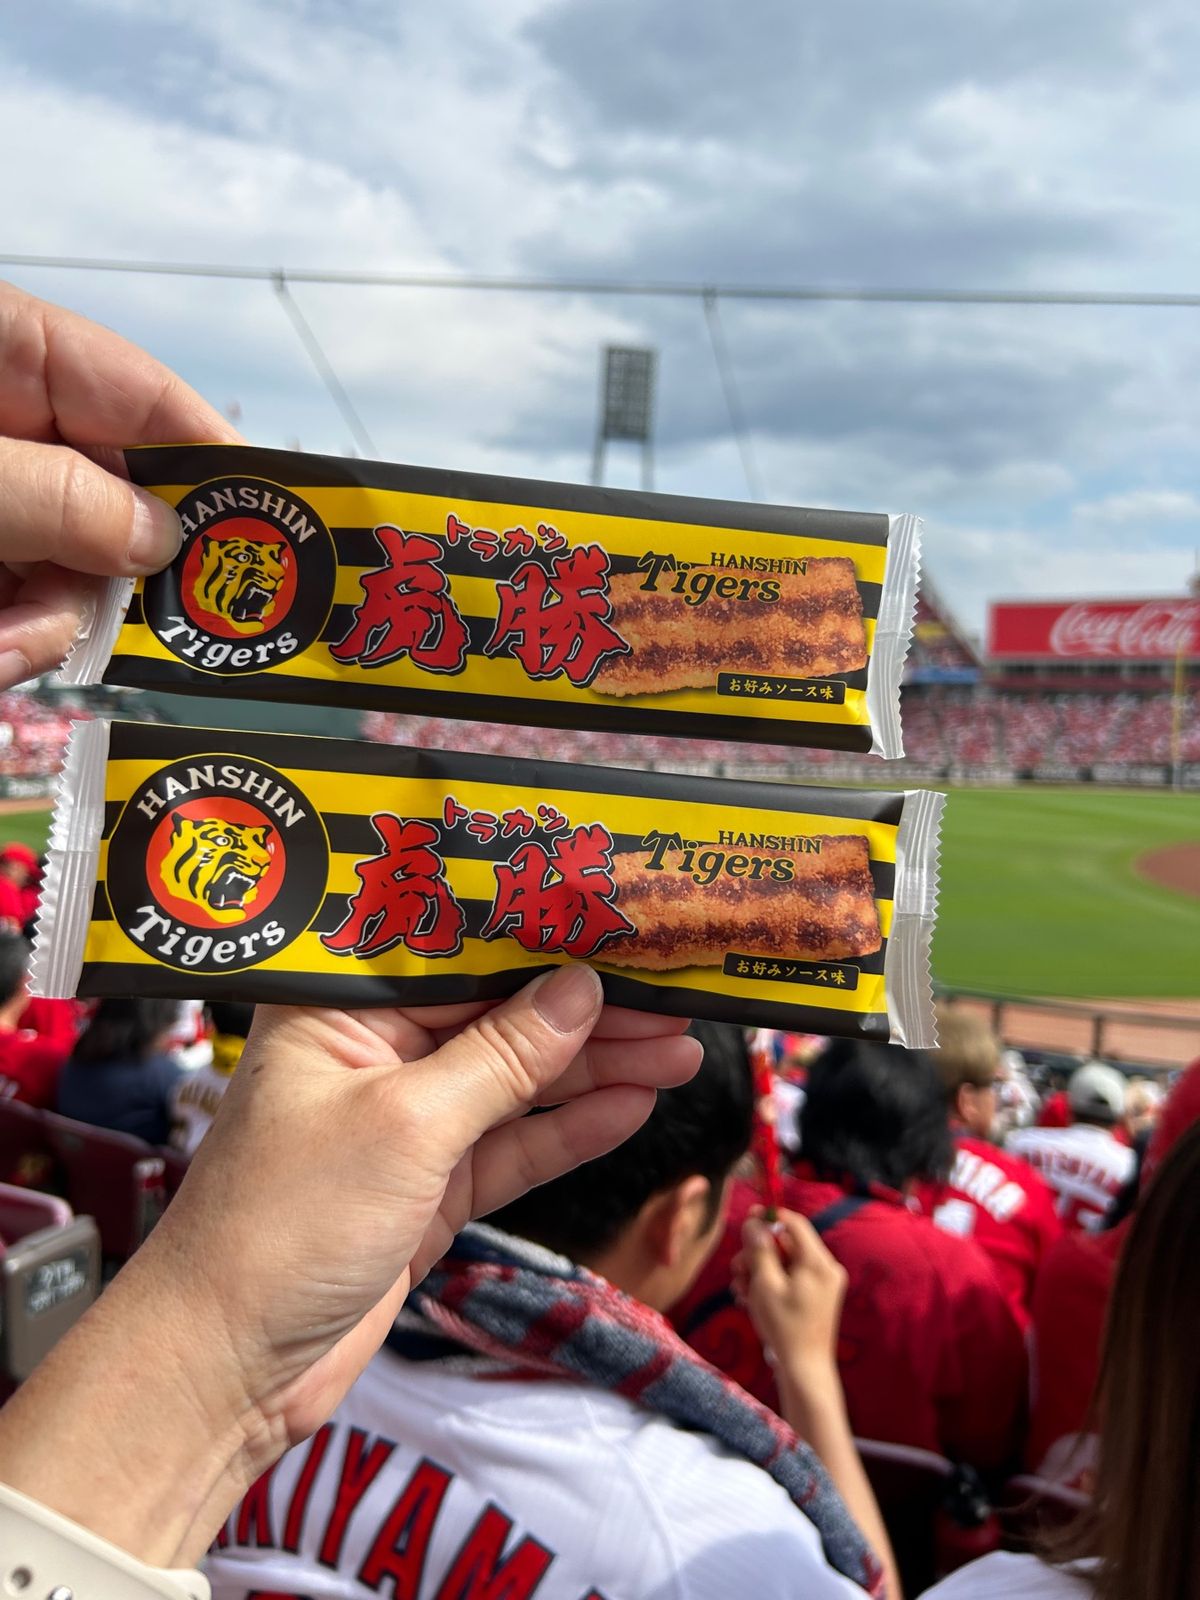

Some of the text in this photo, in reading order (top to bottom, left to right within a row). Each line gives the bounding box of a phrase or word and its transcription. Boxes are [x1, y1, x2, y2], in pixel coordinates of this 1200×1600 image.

[180, 486, 317, 543] HANSHIN
[636, 550, 781, 606] Tigers
[710, 551, 808, 576] HANSHIN
[157, 615, 300, 669] Tigers
[728, 677, 836, 700] お好みソース味
[136, 764, 307, 828] HANSHIN
[641, 829, 795, 885] Tigers
[718, 830, 822, 855] HANSHIN
[128, 904, 288, 967] Tigers
[736, 958, 847, 985] お好みソース味
[207, 1422, 604, 1600] KIYAM
